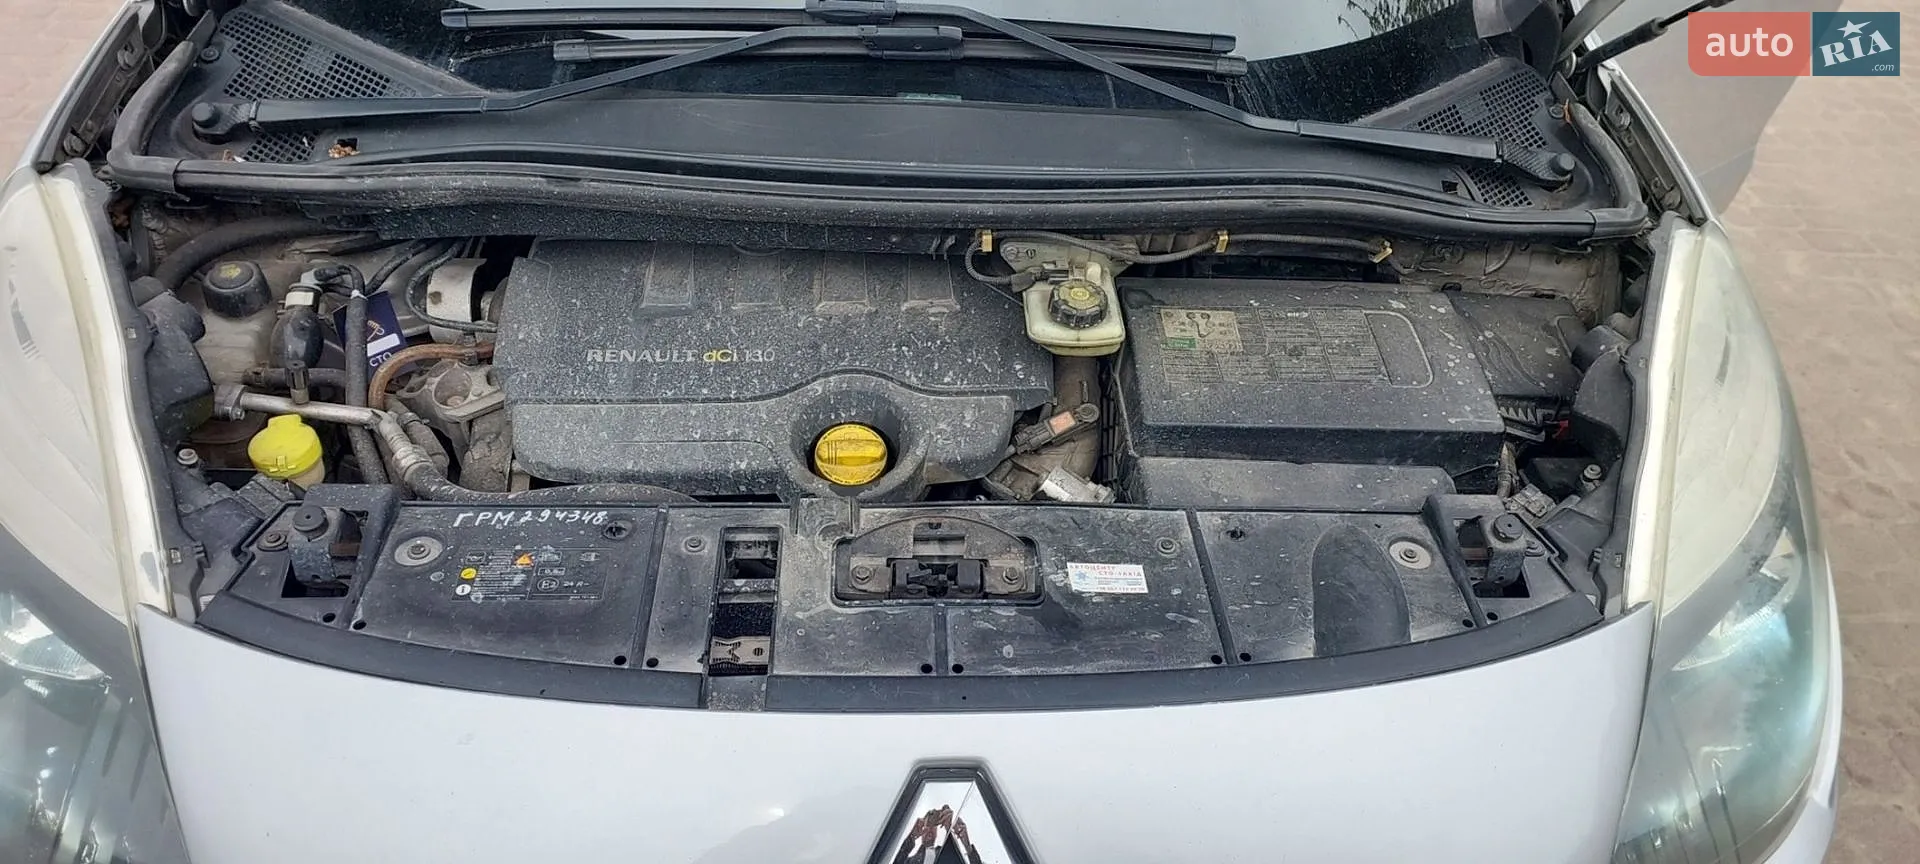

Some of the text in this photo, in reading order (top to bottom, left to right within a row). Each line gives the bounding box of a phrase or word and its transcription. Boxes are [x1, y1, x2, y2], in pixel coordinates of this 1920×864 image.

[586, 349, 698, 363] RENAULT
[745, 349, 775, 362] 130
[452, 509, 608, 527] ГРМ 294348
